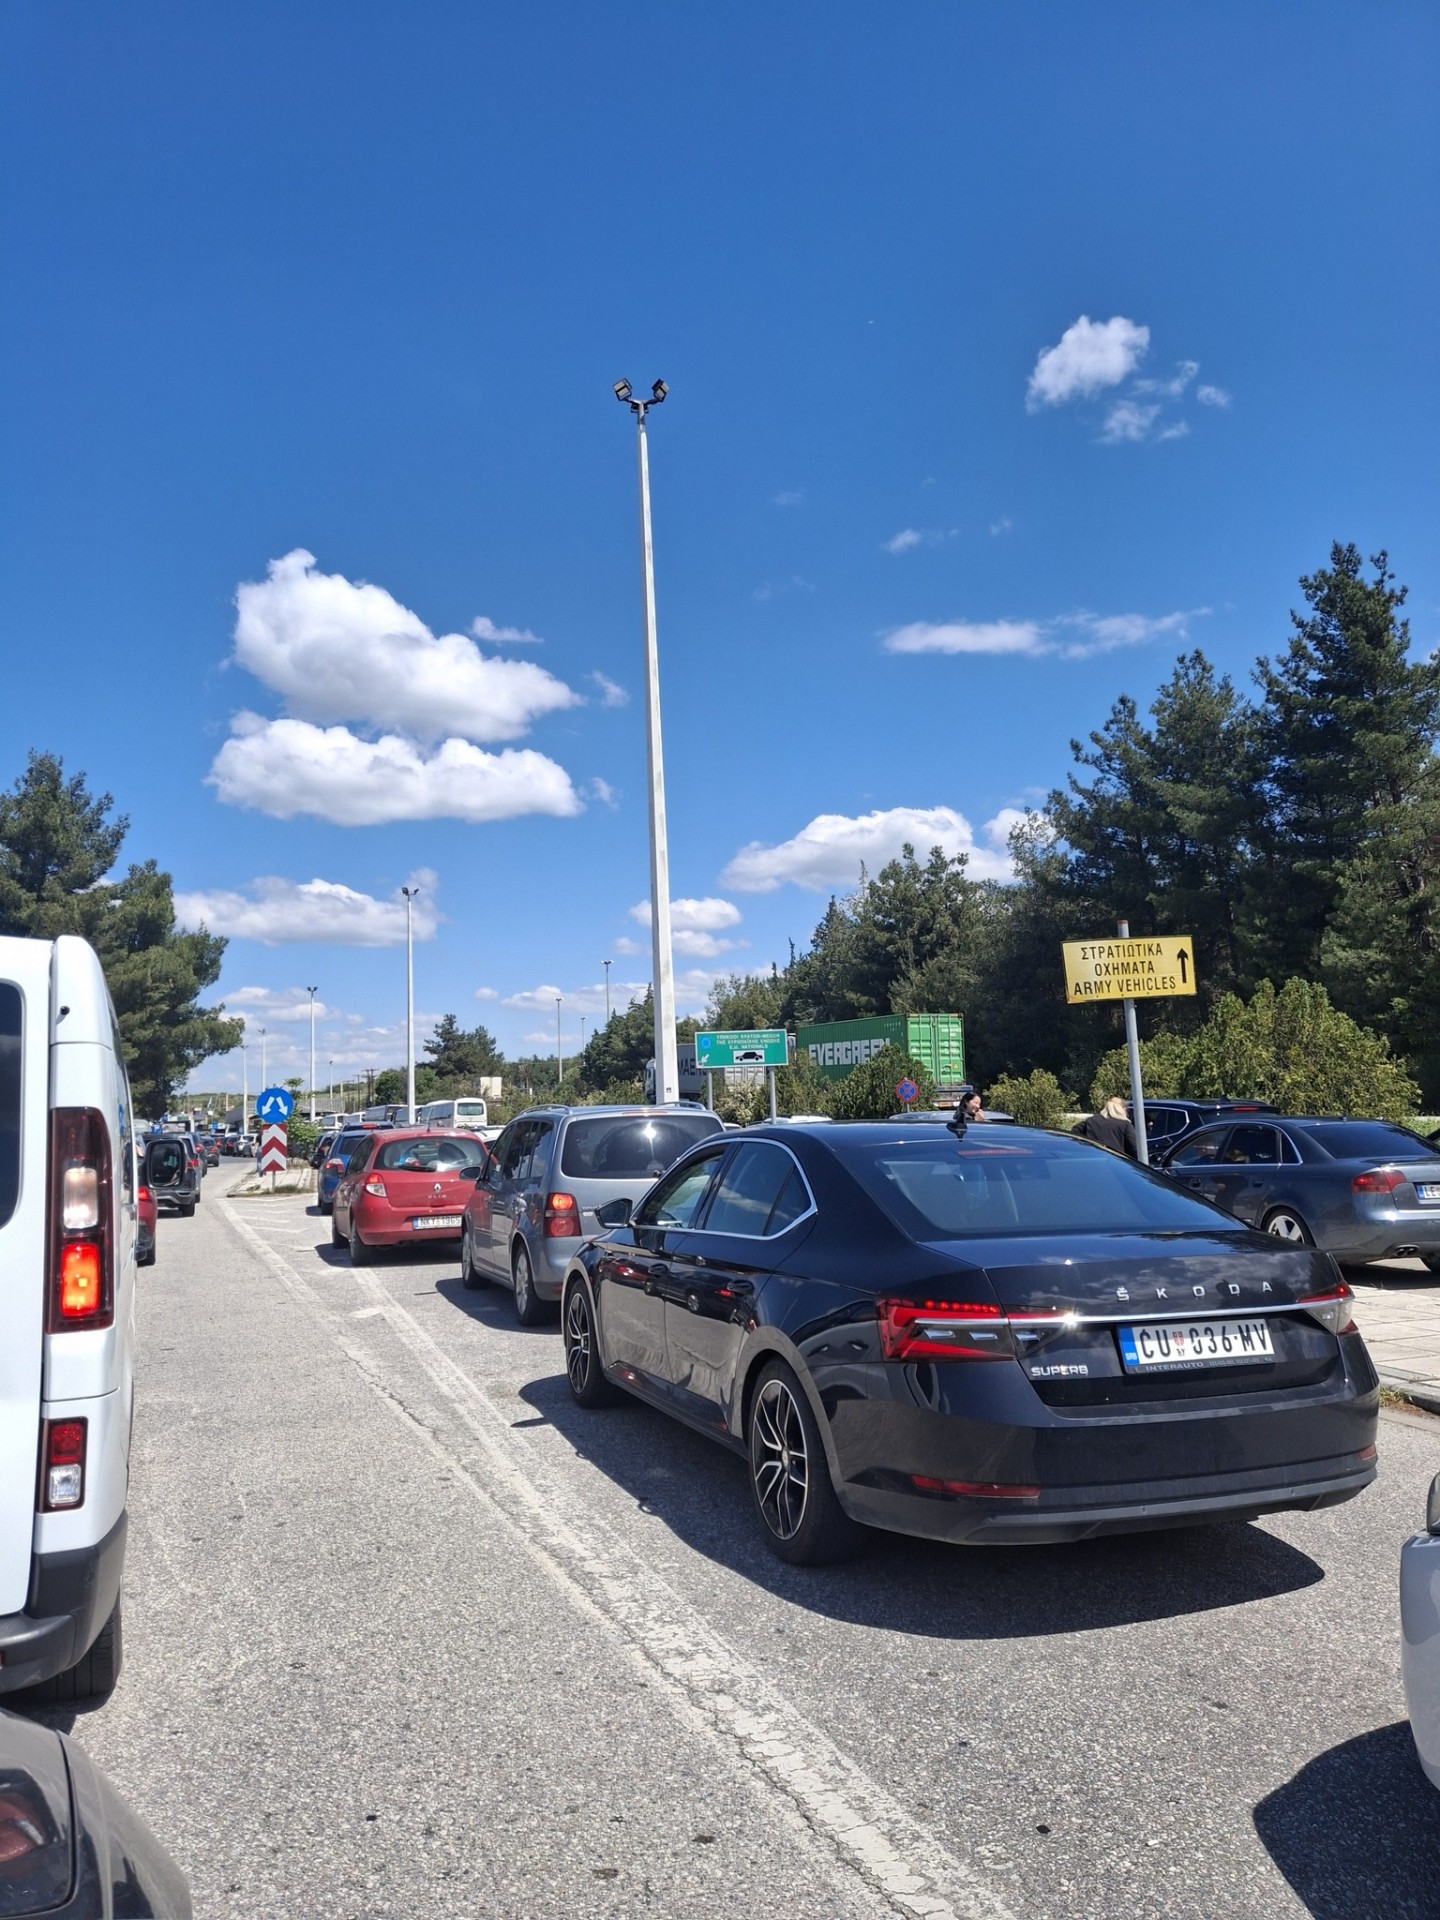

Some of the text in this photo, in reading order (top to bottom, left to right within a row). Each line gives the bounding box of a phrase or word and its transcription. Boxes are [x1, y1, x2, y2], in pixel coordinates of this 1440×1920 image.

[1081, 943, 1163, 960] ΣΤΡΑΤΙΩΤΙΚΑ
[1095, 960, 1155, 977] ΟΧΗΜΑΤΑ
[1074, 976, 1176, 996] ARMY VEHICLES
[1116, 1281, 1273, 1301] ŠKODA
[1031, 1364, 1089, 1377] SUPERB
[1145, 1361, 1204, 1372] INTERAUTO
